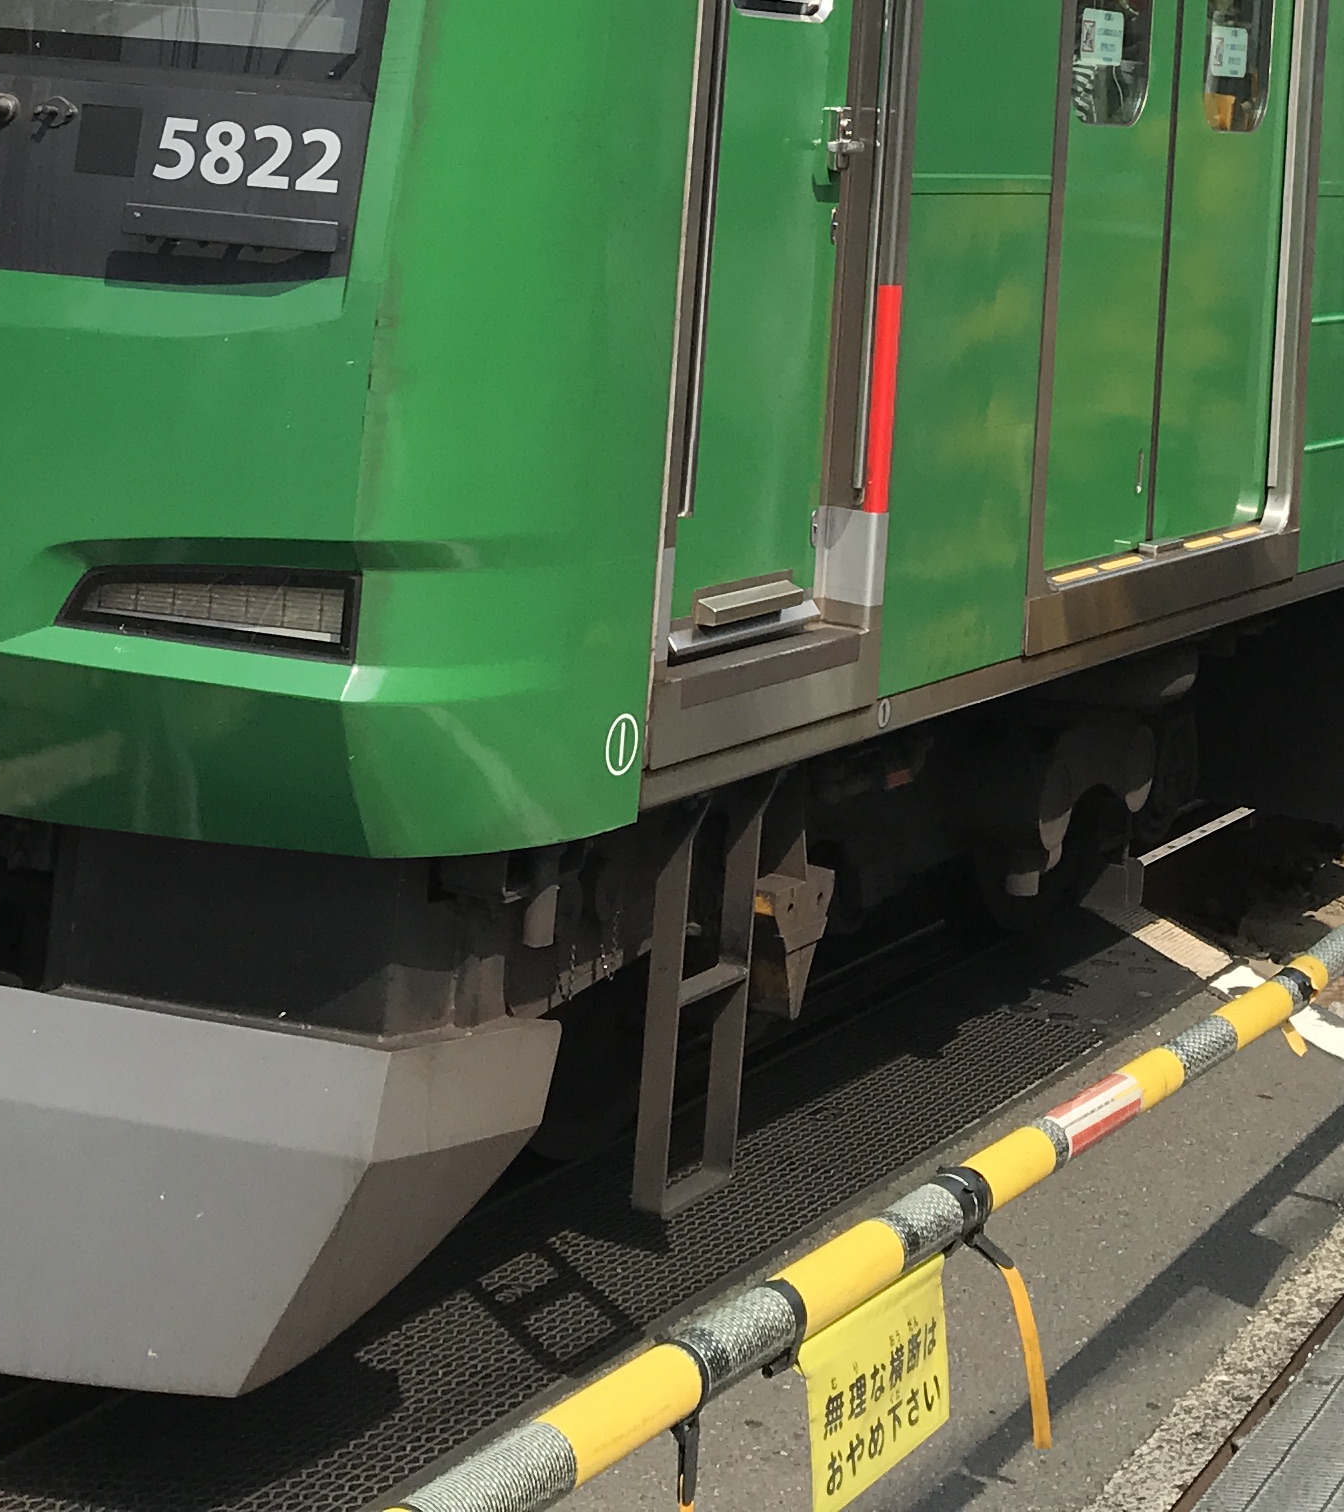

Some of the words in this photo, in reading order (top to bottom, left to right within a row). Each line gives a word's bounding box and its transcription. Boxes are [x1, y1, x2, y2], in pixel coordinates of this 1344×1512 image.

[152, 116, 342, 194] 5822
[823, 1316, 937, 1441] 無理な横断は
[826, 1375, 940, 1496] おやめ下さい
